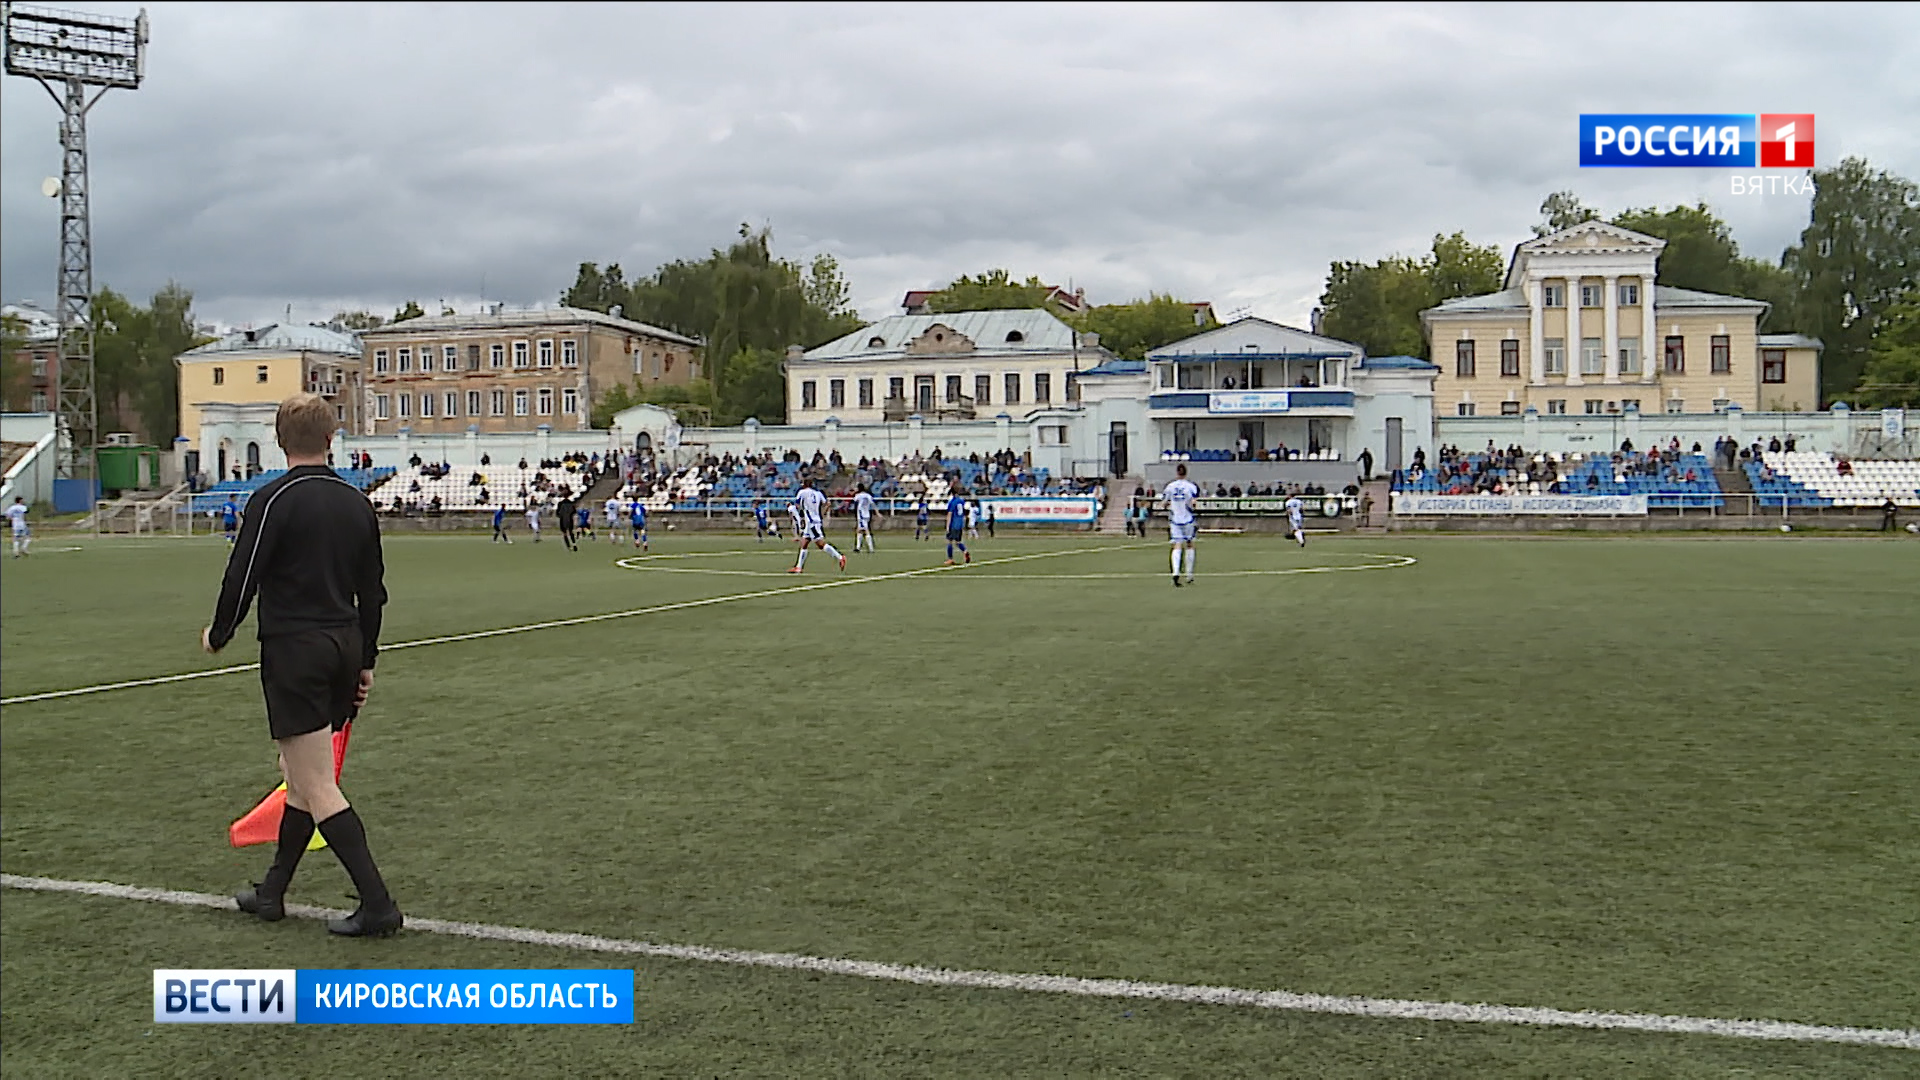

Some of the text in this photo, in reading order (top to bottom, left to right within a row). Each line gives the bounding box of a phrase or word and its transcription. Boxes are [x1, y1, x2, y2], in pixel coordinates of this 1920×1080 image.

[1417, 499, 1466, 510] ИСТОРИЯ
[1469, 499, 1513, 510] СТРАНЫ
[1523, 499, 1572, 510] ИСТОРИЯ
